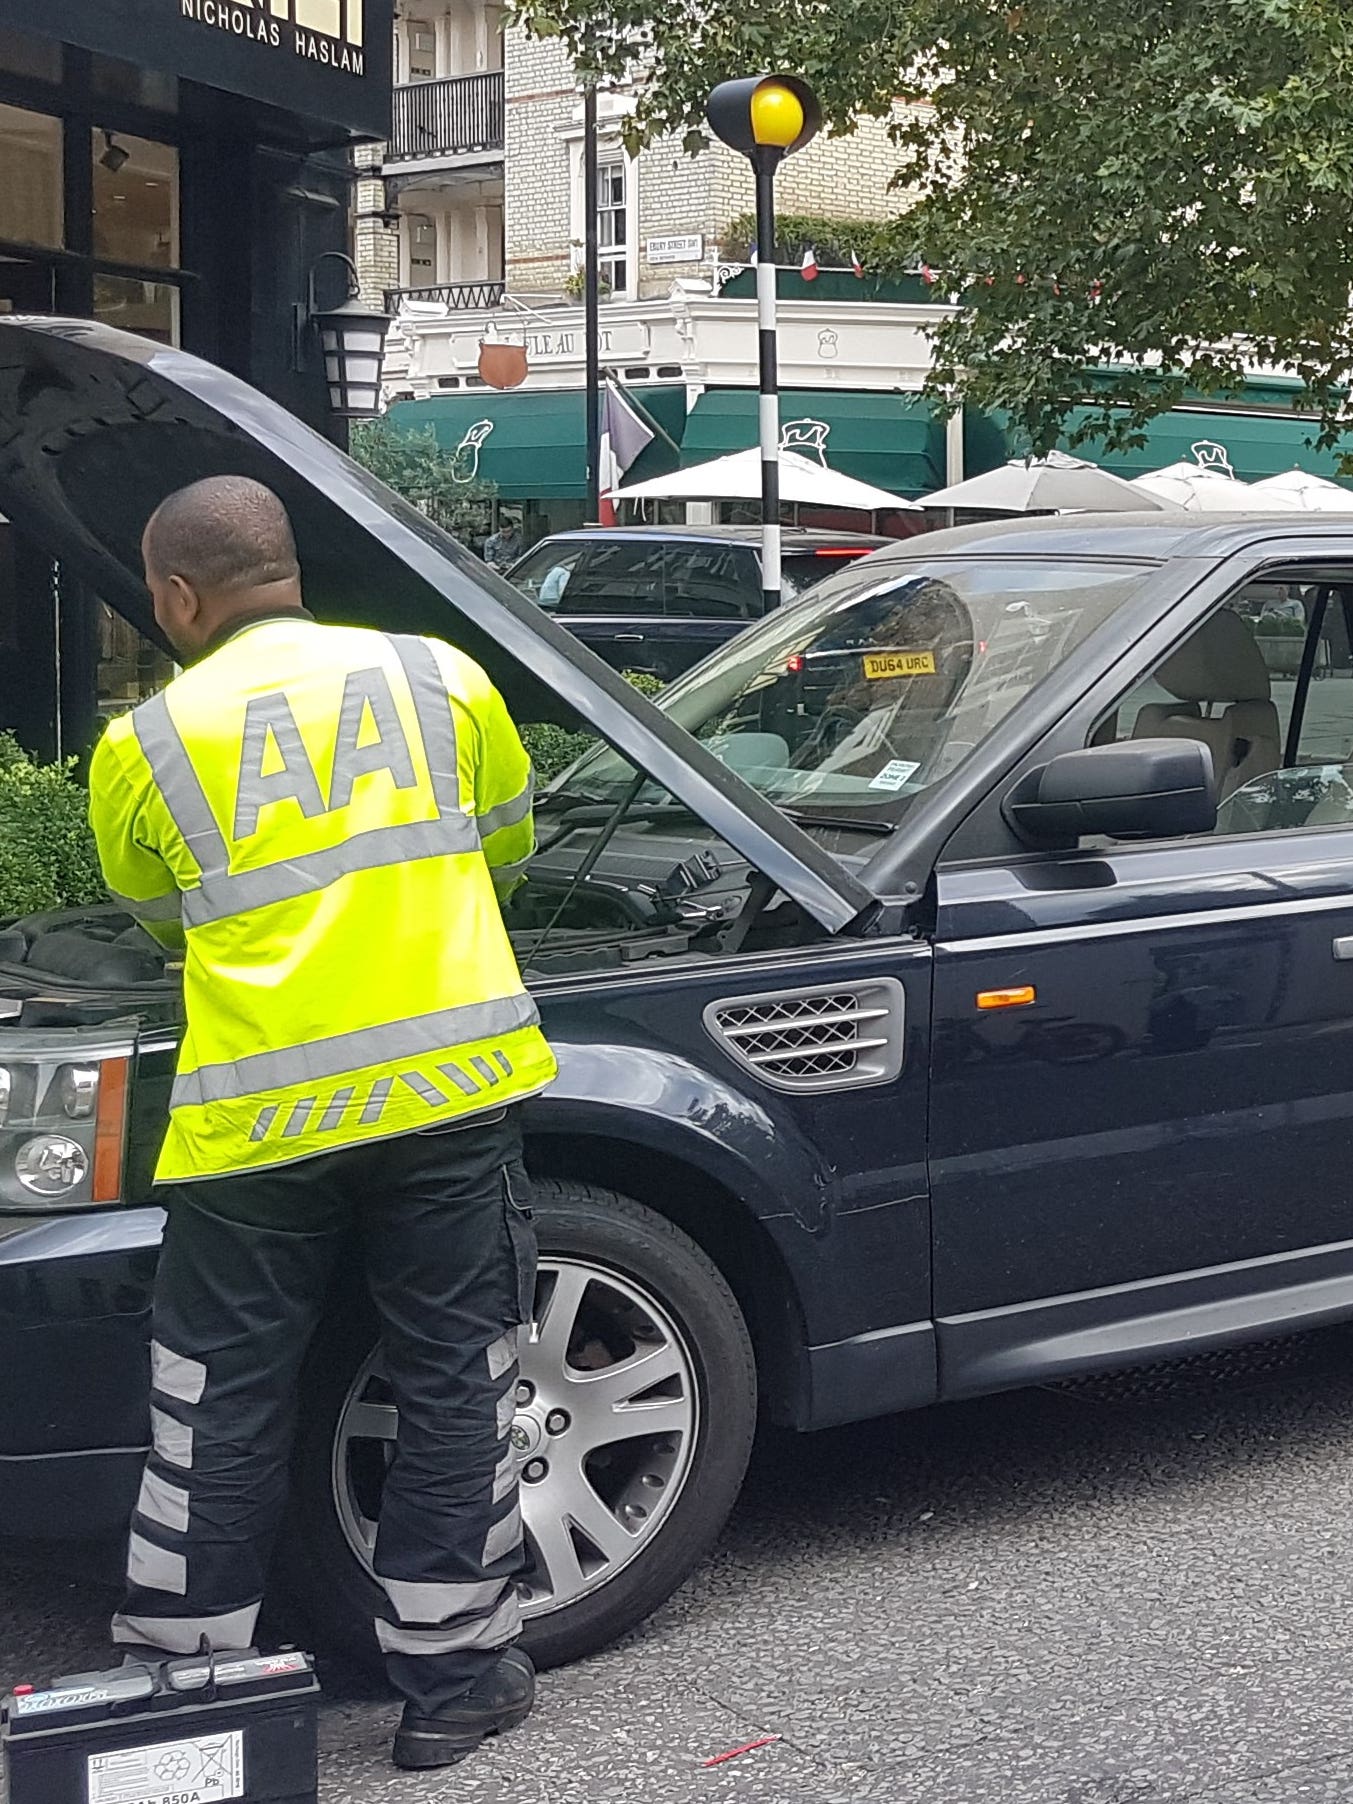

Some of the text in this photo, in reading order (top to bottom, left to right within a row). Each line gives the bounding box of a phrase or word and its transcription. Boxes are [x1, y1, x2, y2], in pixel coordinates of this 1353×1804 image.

[181, 0, 280, 47] NICHOLAS
[295, 31, 364, 76] HASLAM
[870, 658, 903, 673] DU64
[233, 667, 417, 842] AA
